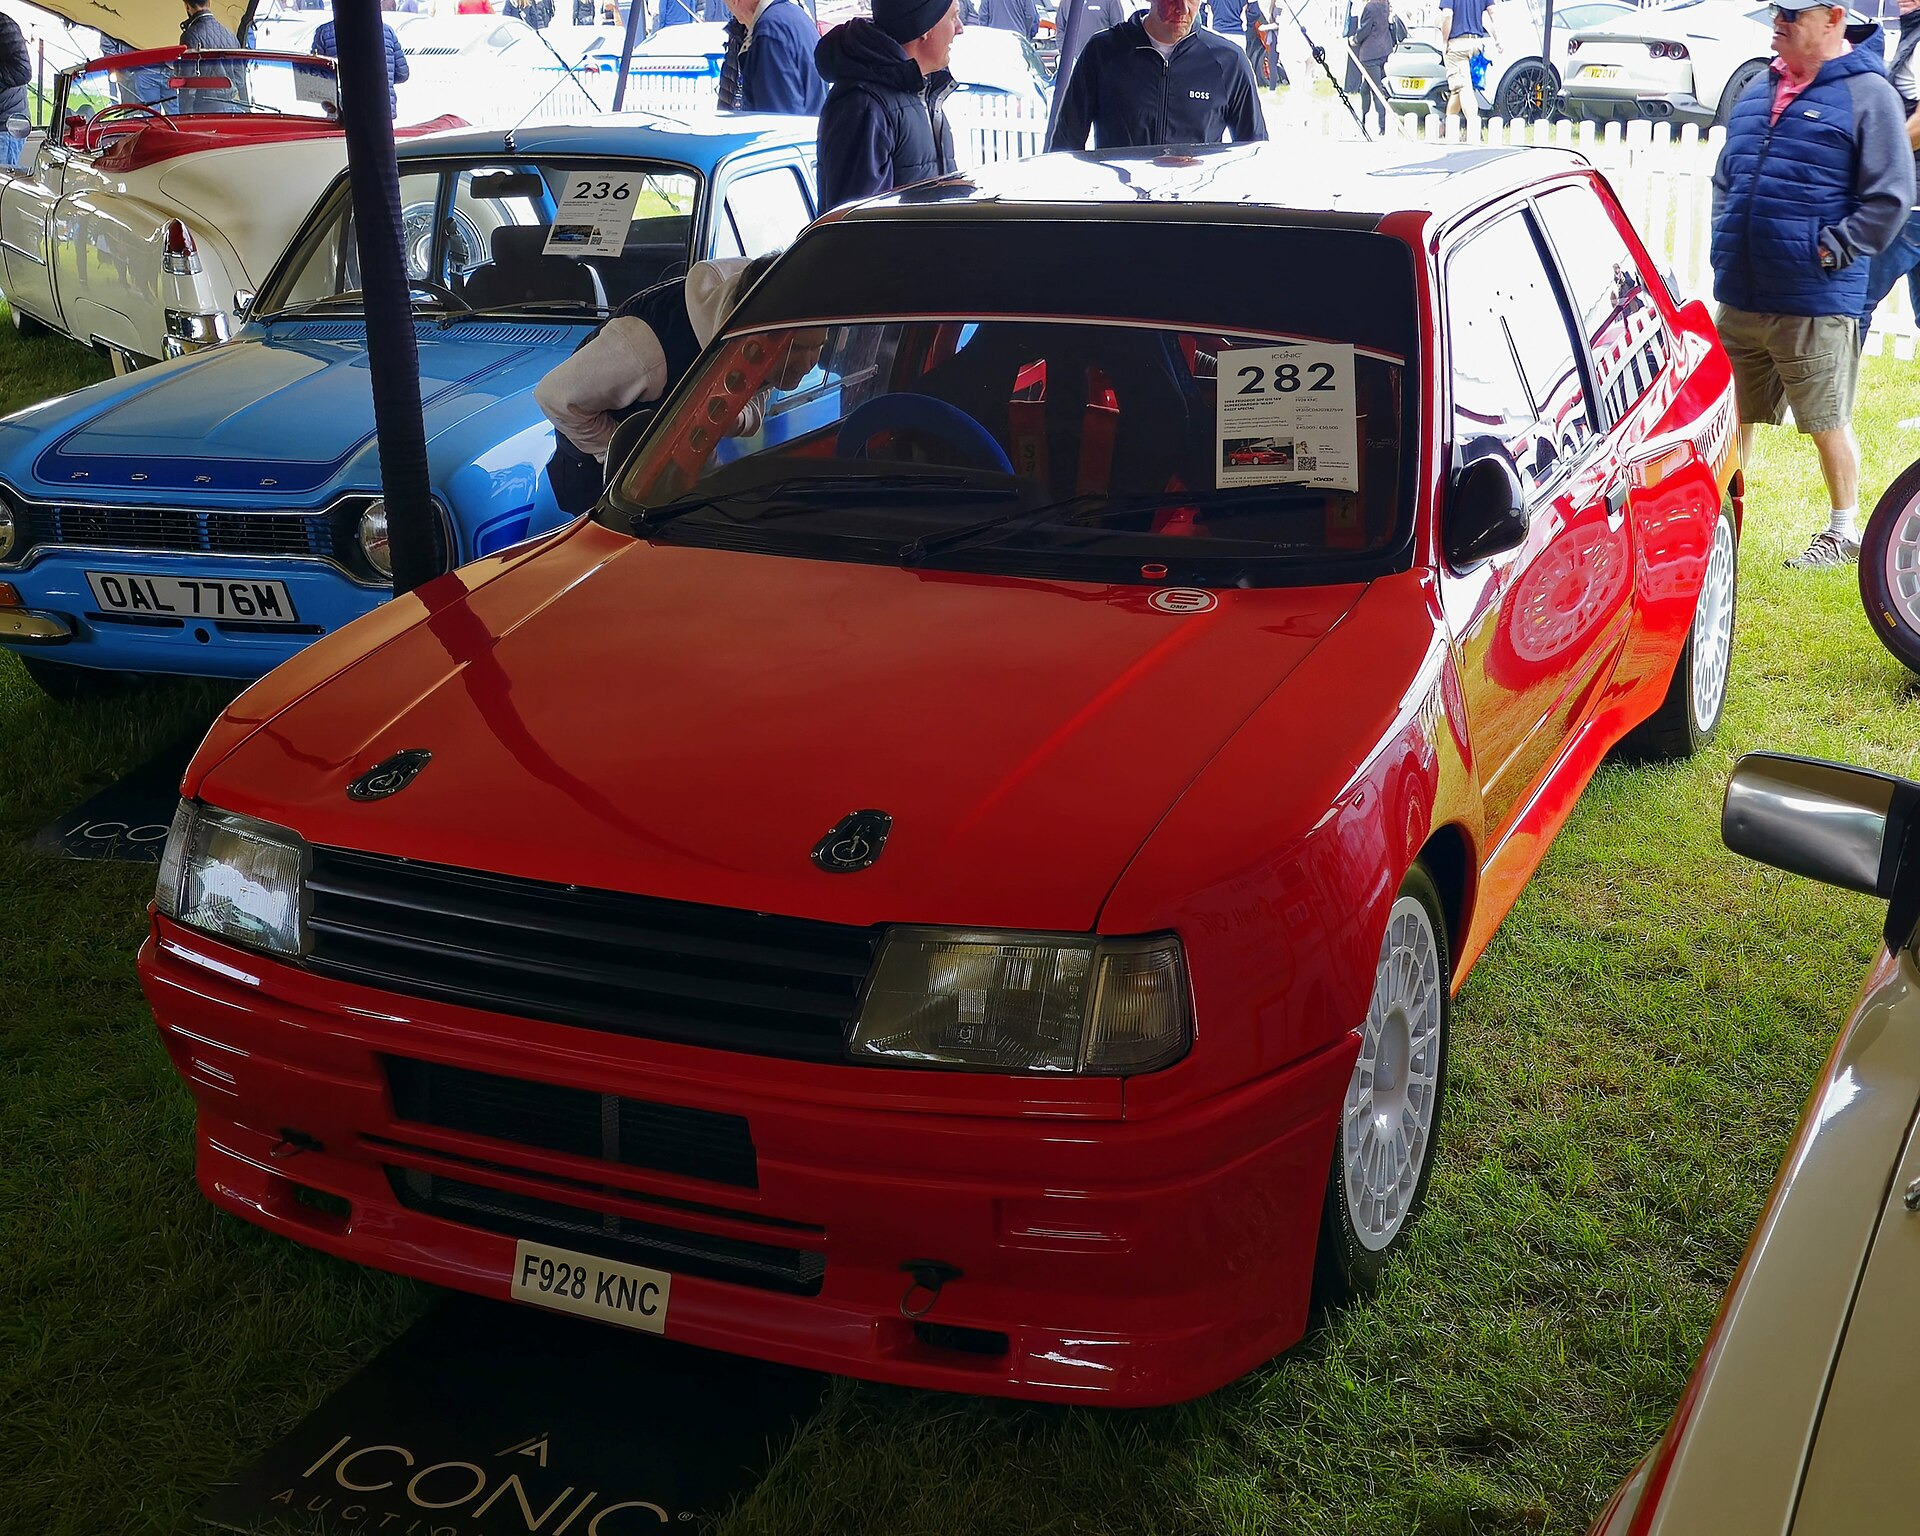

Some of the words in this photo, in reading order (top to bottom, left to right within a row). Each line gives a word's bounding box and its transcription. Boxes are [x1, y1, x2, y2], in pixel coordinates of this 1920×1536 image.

[1189, 91, 1210, 100] BOSS
[573, 182, 630, 200] 236
[1236, 362, 1336, 395] 282
[71, 471, 278, 486] FORD
[100, 576, 176, 612] OAL
[178, 581, 283, 618] 776M
[521, 1254, 587, 1300] F928
[594, 1271, 660, 1316] KNC
[302, 1435, 669, 1536] ICONIC
